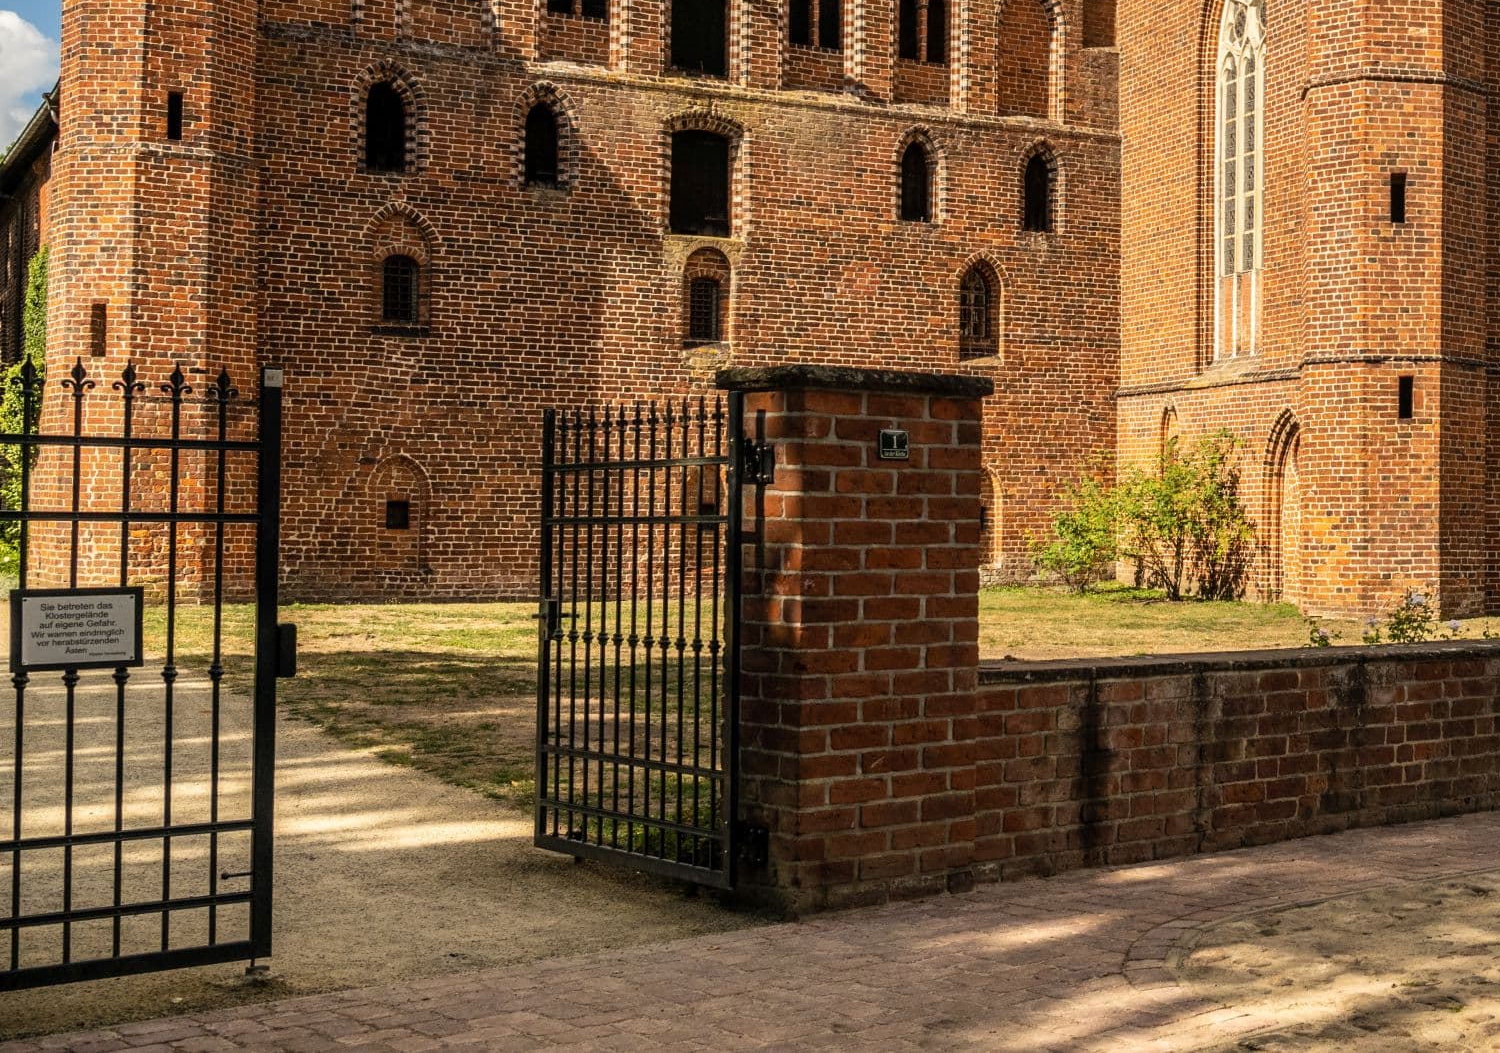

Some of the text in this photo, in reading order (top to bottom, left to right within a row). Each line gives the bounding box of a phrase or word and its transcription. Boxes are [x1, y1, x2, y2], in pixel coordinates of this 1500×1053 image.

[893, 435, 898, 449] 1
[40, 602, 113, 612] Sie betreten das
[45, 610, 109, 621] Klostergelände
[39, 619, 118, 630] auf eigene Gefahr.
[79, 628, 125, 637] eindringlich
[52, 637, 120, 647] herabstürzenden
